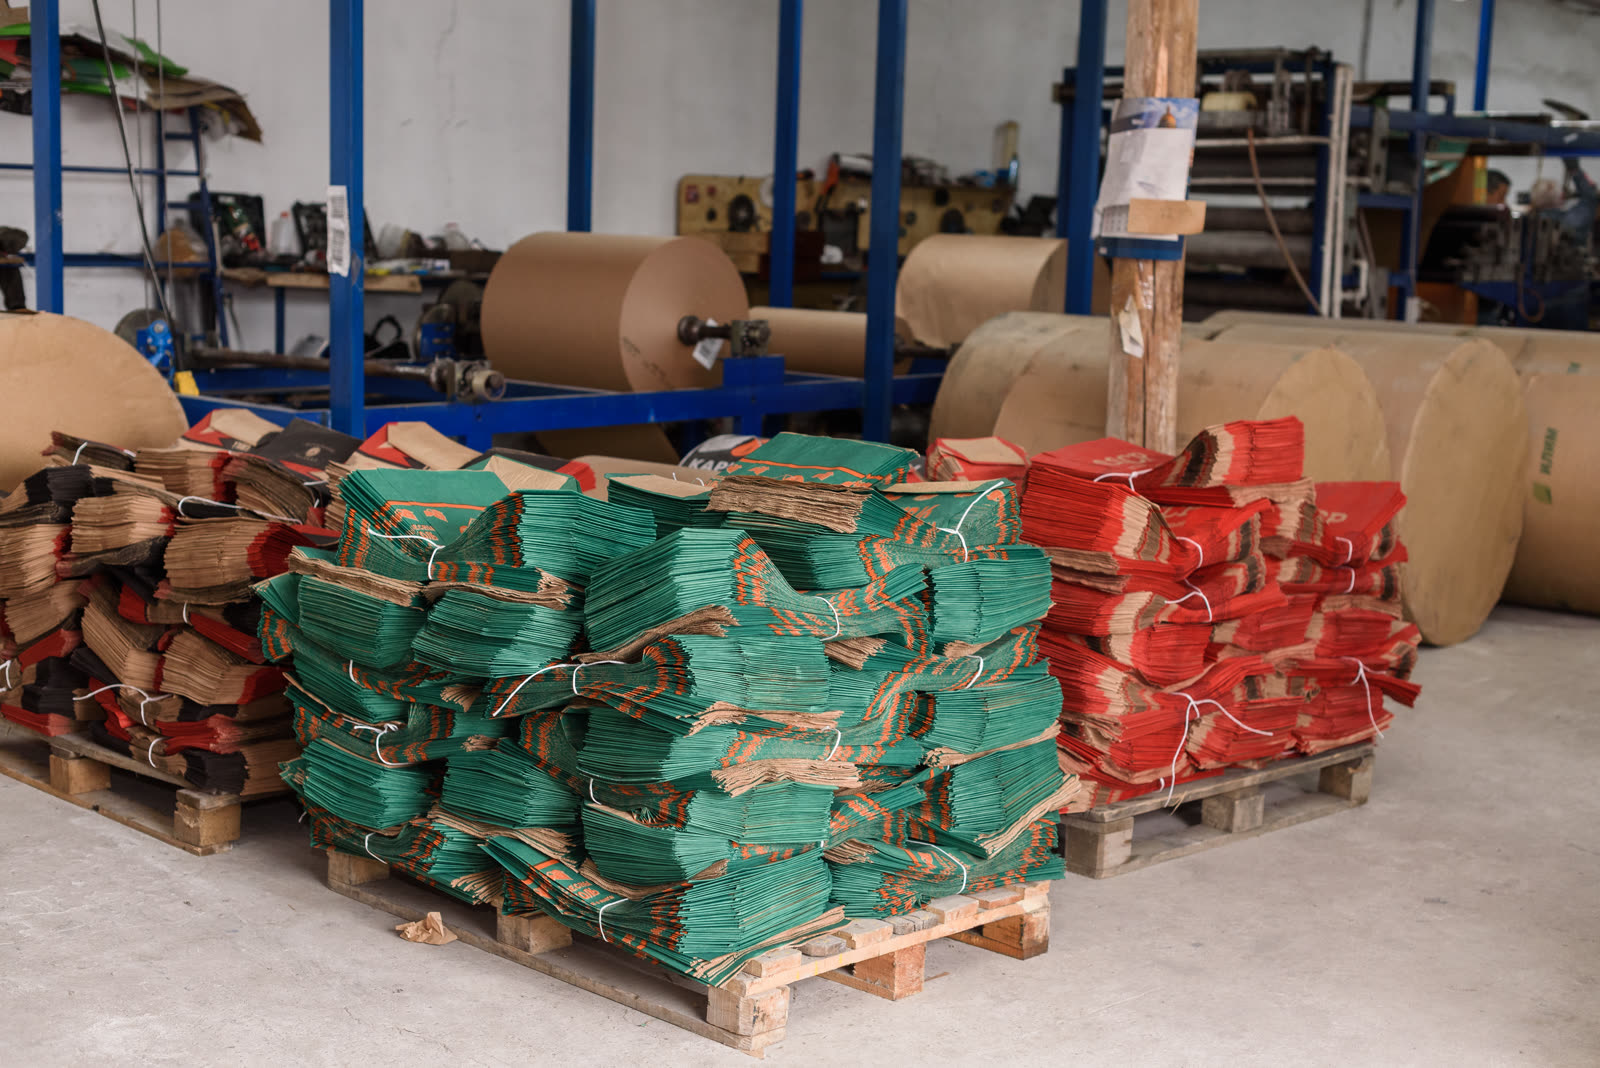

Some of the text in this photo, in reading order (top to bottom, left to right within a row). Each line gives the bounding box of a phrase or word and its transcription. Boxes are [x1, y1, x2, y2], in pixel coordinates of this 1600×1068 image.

[1540, 427, 1558, 475] ИЛИМ
[688, 458, 735, 473] КАР
[575, 887, 600, 900] ОЛЬ
